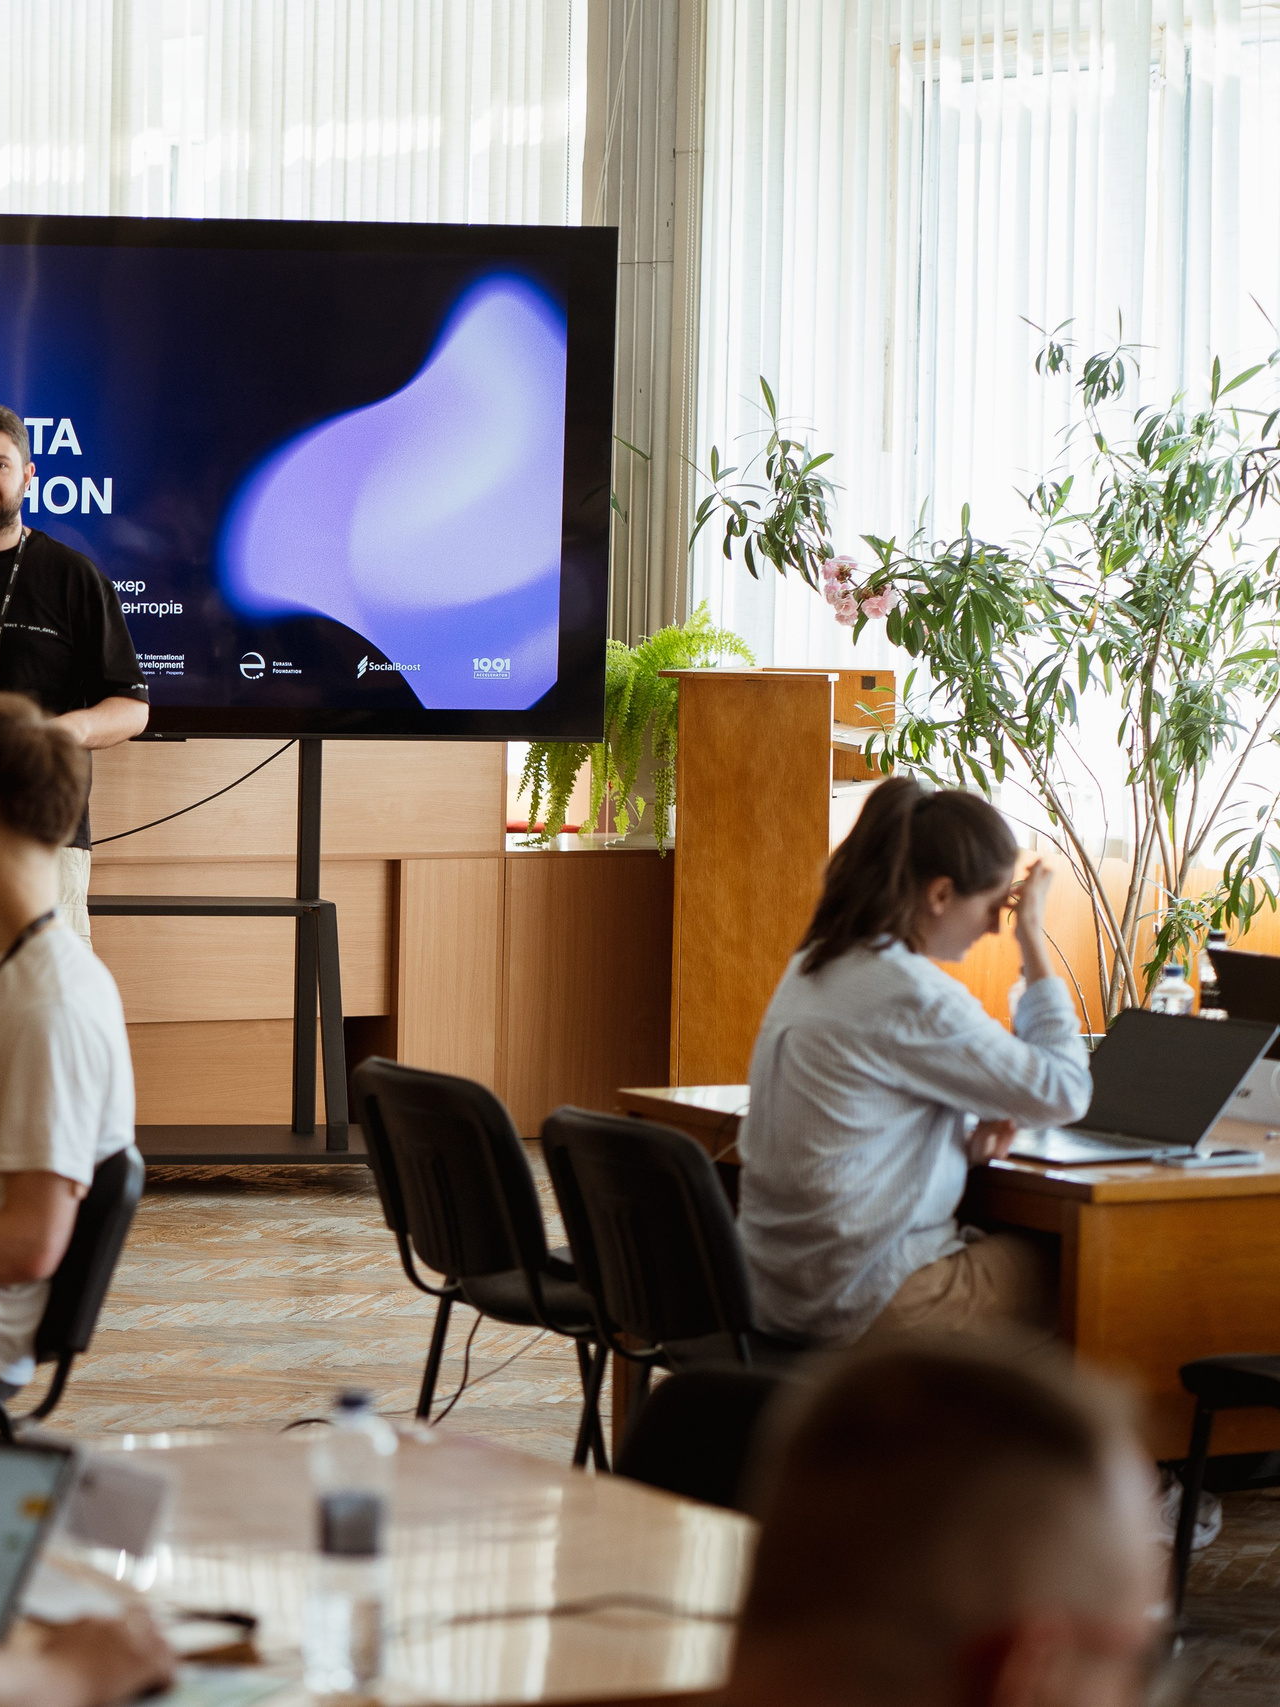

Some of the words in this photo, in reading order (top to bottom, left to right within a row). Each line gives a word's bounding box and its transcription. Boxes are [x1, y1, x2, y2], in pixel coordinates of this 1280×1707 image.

[112, 580, 146, 596] жер
[121, 600, 183, 618] енторів
[138, 660, 184, 670] evelopment
[368, 661, 421, 672] SocialBoost
[473, 657, 511, 673] 1991
